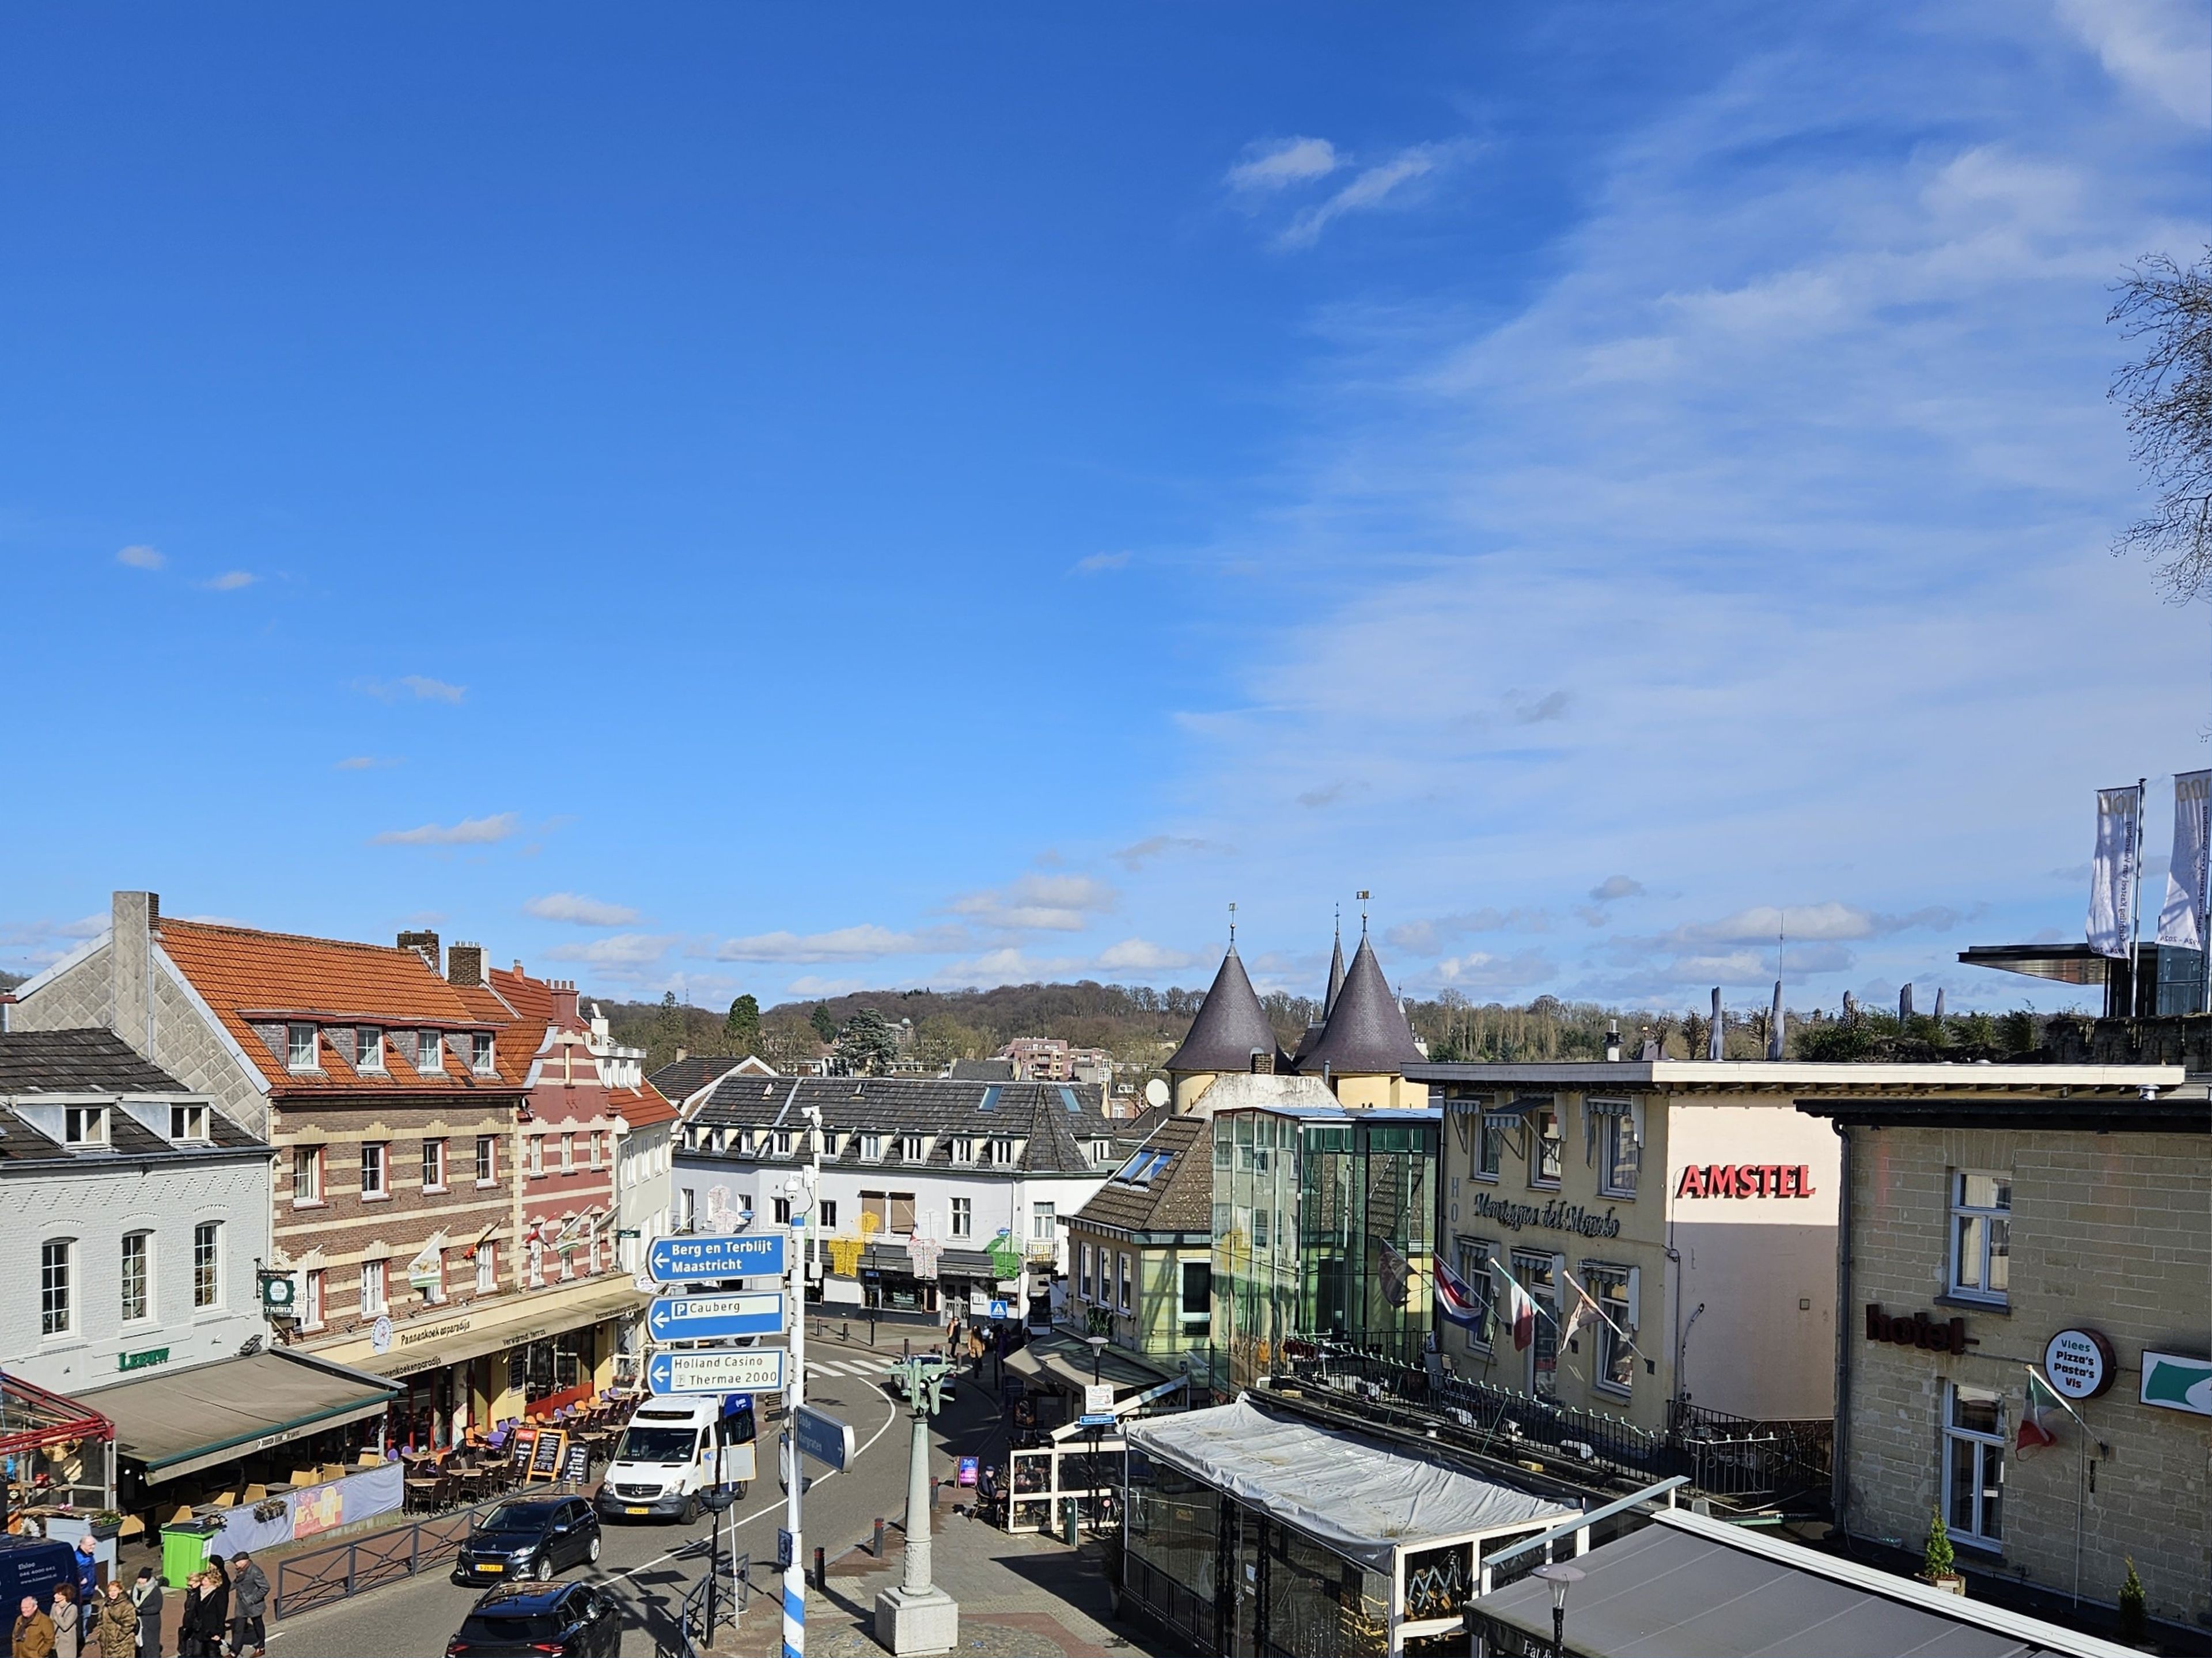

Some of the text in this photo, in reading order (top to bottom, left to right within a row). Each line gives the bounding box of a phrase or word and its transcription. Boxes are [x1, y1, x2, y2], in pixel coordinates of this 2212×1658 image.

[1676, 1164, 1816, 1198] AMSTEL
[672, 1240, 772, 1257] Berg en Terblijt
[672, 1259, 742, 1273] Maastricht
[690, 1302, 740, 1313] Cauberg
[1866, 1304, 1965, 1355] hotel
[502, 1334, 529, 1346] Verwarmd
[2061, 1339, 2090, 1352] Vlees
[675, 1356, 763, 1369] Holland Casino
[2056, 1350, 2094, 1366] Pizza's
[2054, 1363, 2094, 1379] Pasta's
[690, 1372, 777, 1385] Thermae 2000
[2065, 1377, 2082, 1389] Vis
[1523, 1640, 1540, 1658] Eat
